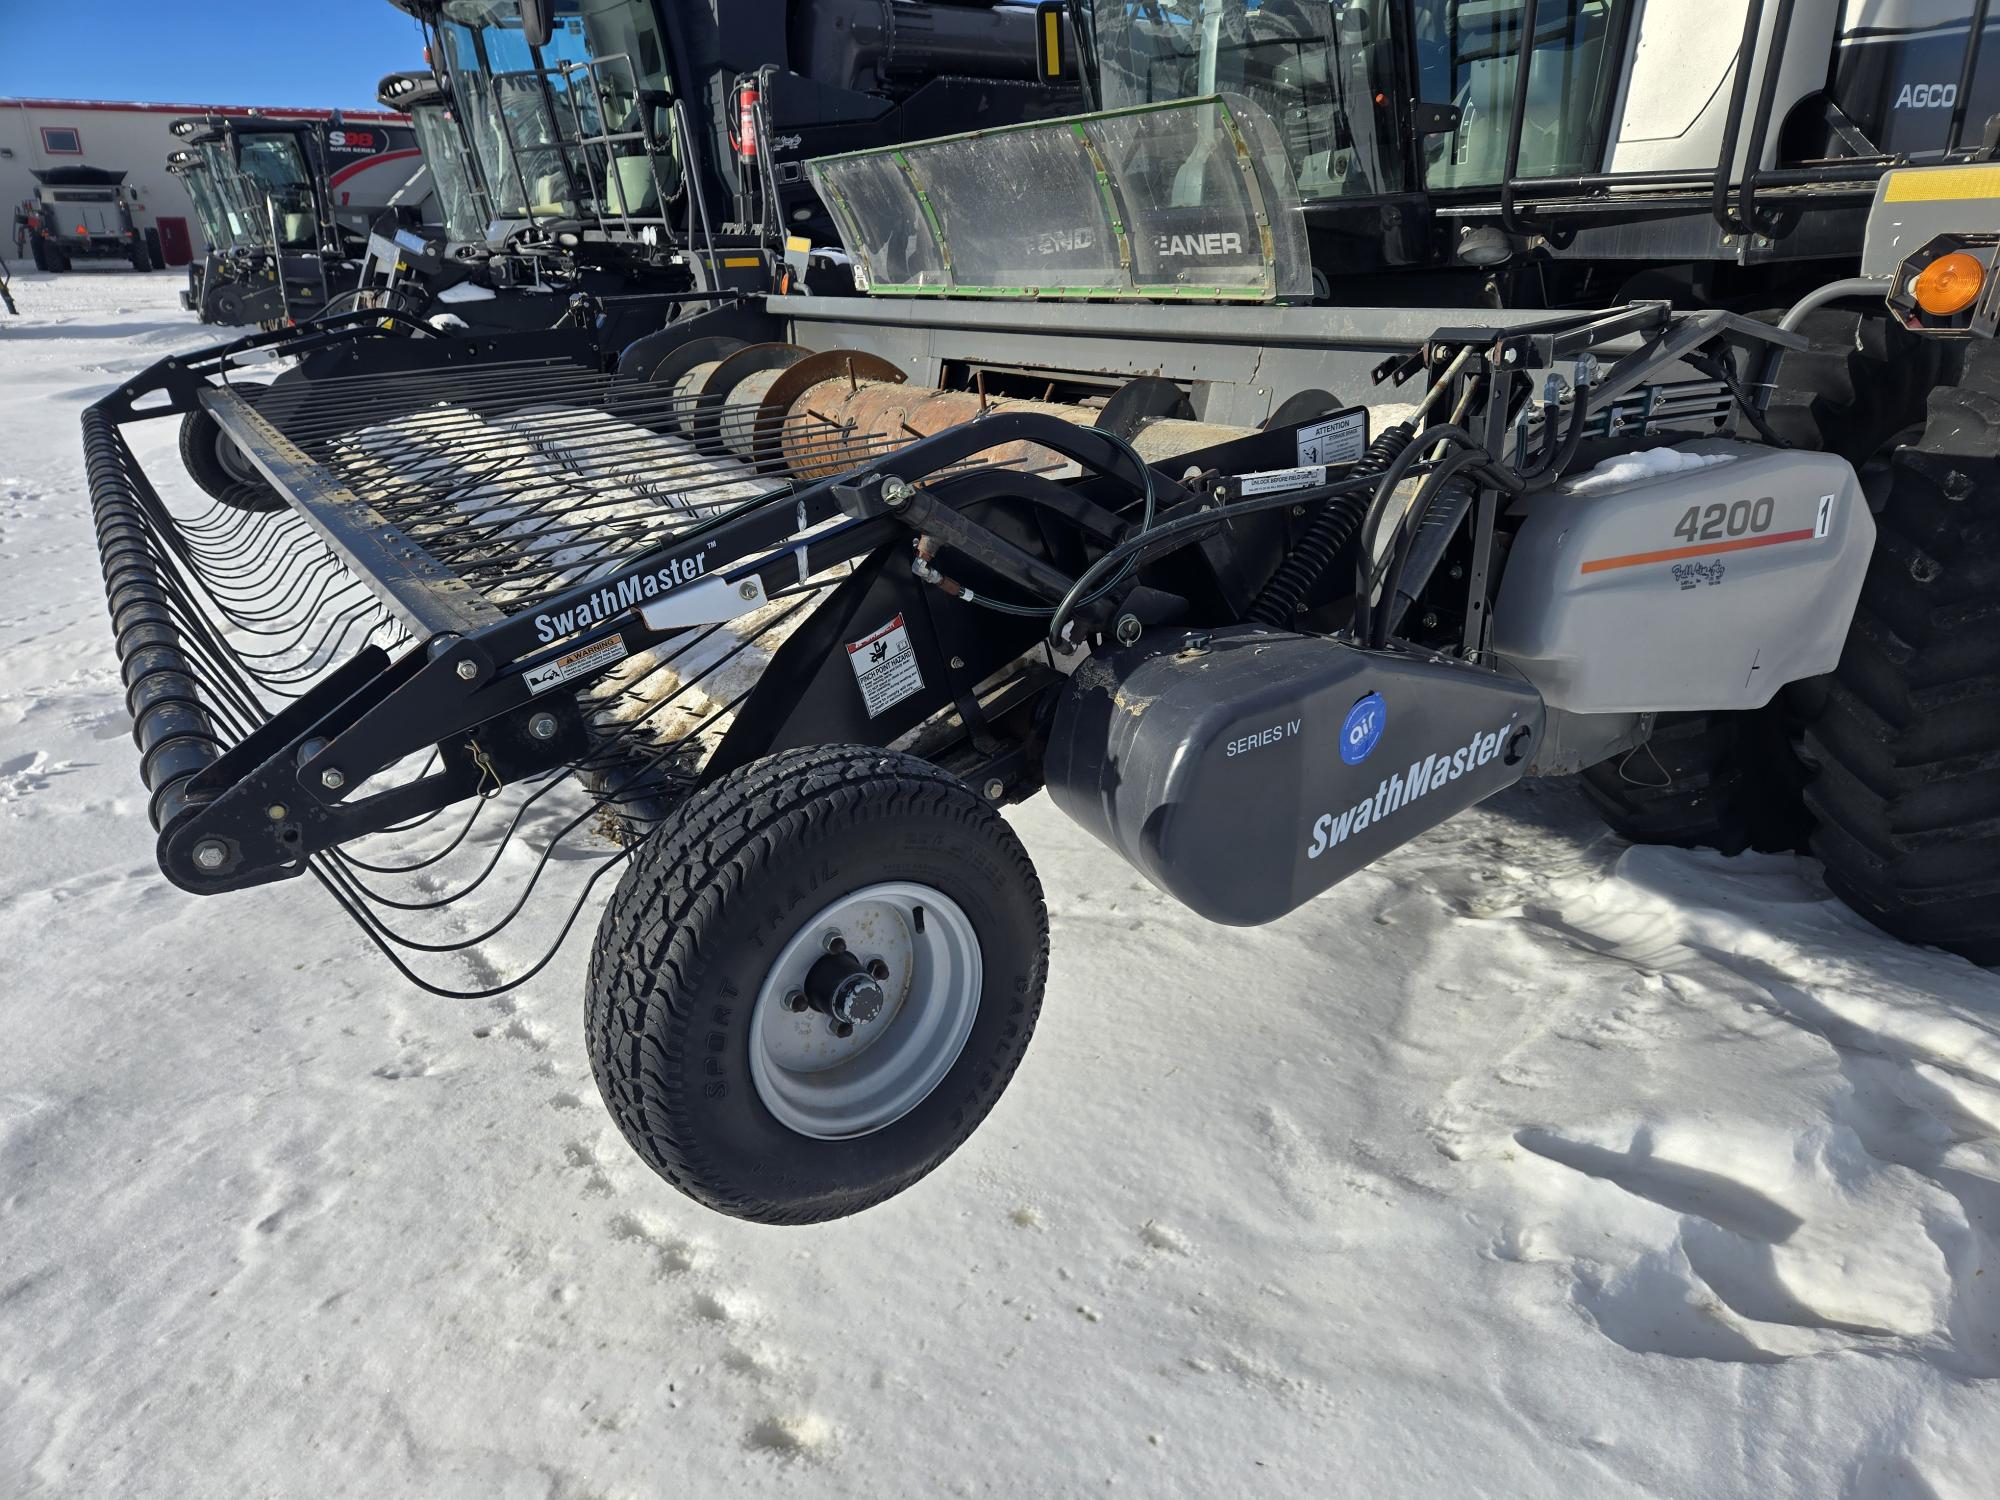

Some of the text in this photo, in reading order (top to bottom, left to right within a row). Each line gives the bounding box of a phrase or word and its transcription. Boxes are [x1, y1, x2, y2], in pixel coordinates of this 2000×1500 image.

[1894, 84, 1957, 109] AGCO
[329, 131, 374, 147] S98
[1315, 420, 1350, 436] ATTENTION
[1251, 478, 1270, 486] UNLOCK
[1270, 476, 1288, 484] BEFORE
[1673, 496, 1775, 542] 4200
[1820, 498, 1830, 535] 1
[534, 551, 706, 643] SwathMaster
[574, 640, 614, 658] WARNING
[860, 669, 876, 684] PINCH
[875, 661, 892, 676] POINT
[891, 651, 912, 666] HAZARD
[1226, 719, 1302, 757] SERIES IV
[1350, 711, 1375, 745] air
[1307, 723, 1512, 860] SwathMaster
[703, 975, 740, 1099] SPORT
